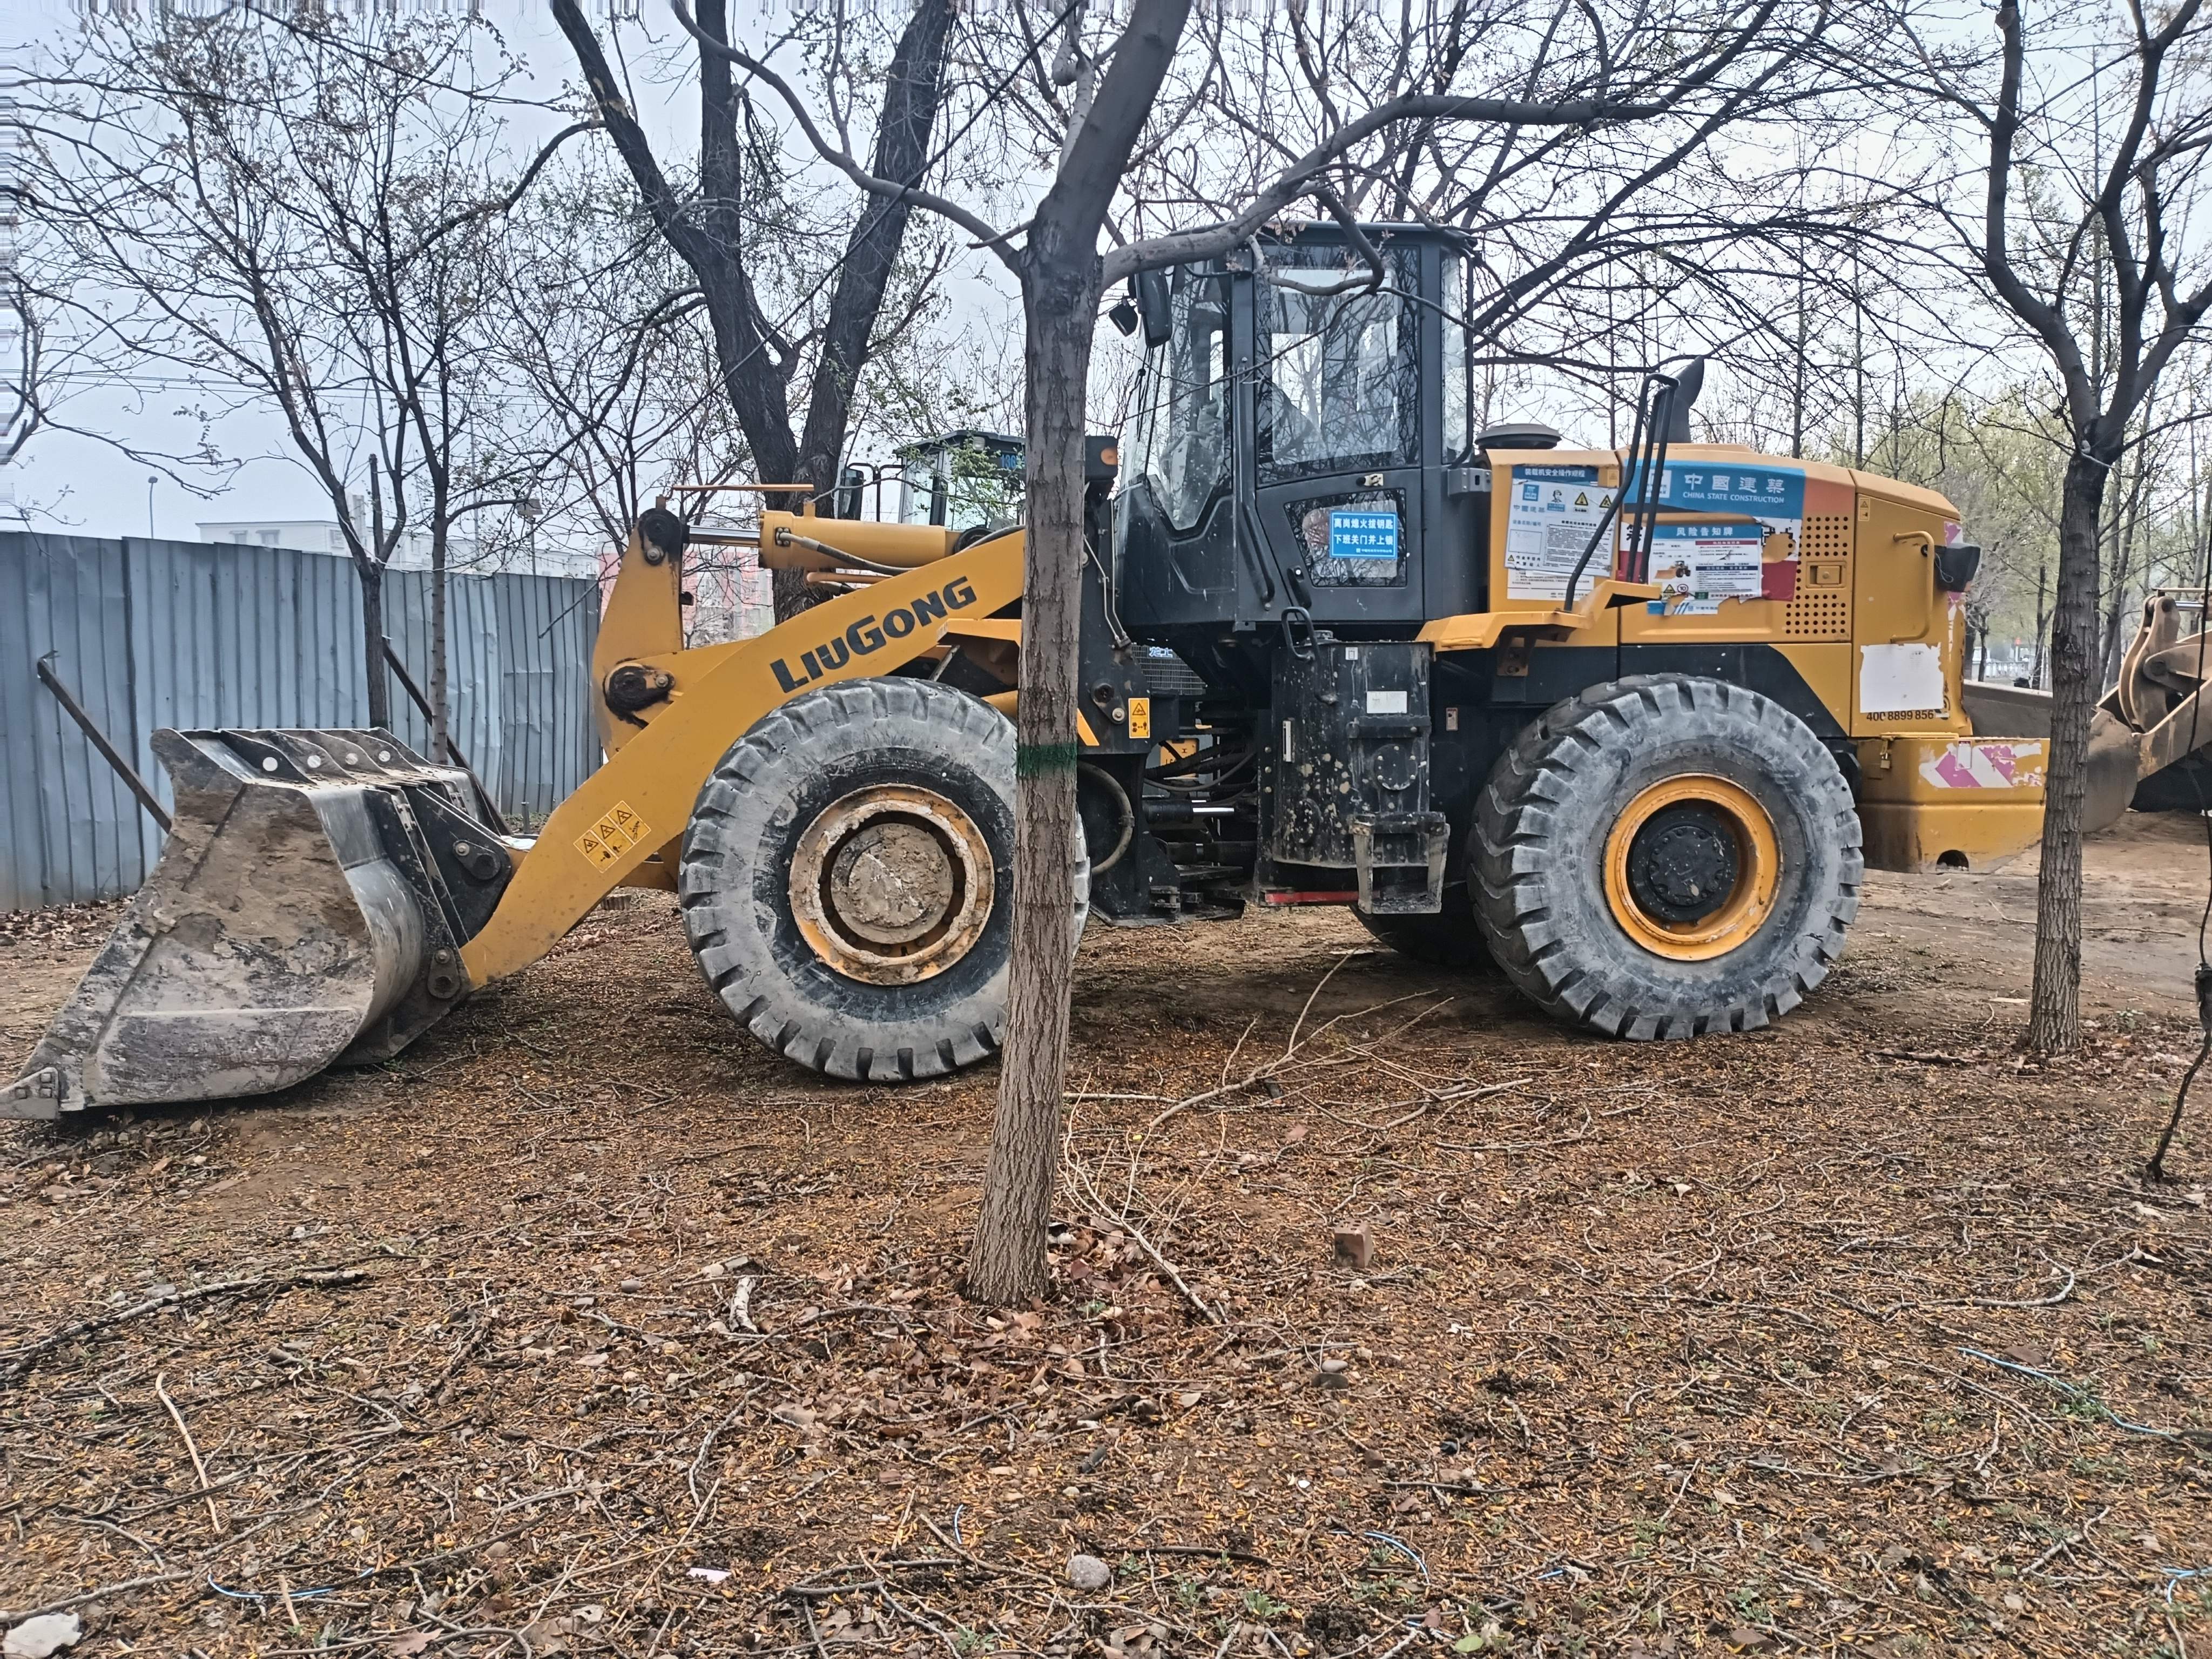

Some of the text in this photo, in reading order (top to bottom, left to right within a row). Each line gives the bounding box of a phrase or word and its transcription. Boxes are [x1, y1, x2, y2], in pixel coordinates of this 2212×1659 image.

[1525, 468, 1586, 478] 装载机安全操作规程
[1707, 493, 1728, 501] STATE
[1730, 494, 1785, 503] CONSTRUCTION
[1334, 518, 1393, 529] 离岗熄火拔钥匙
[1676, 527, 1734, 536] 风险告知牌
[1334, 534, 1393, 545] 下班关门并上锁
[1887, 711, 1913, 720] 8899
[1915, 710, 1934, 720] 856
